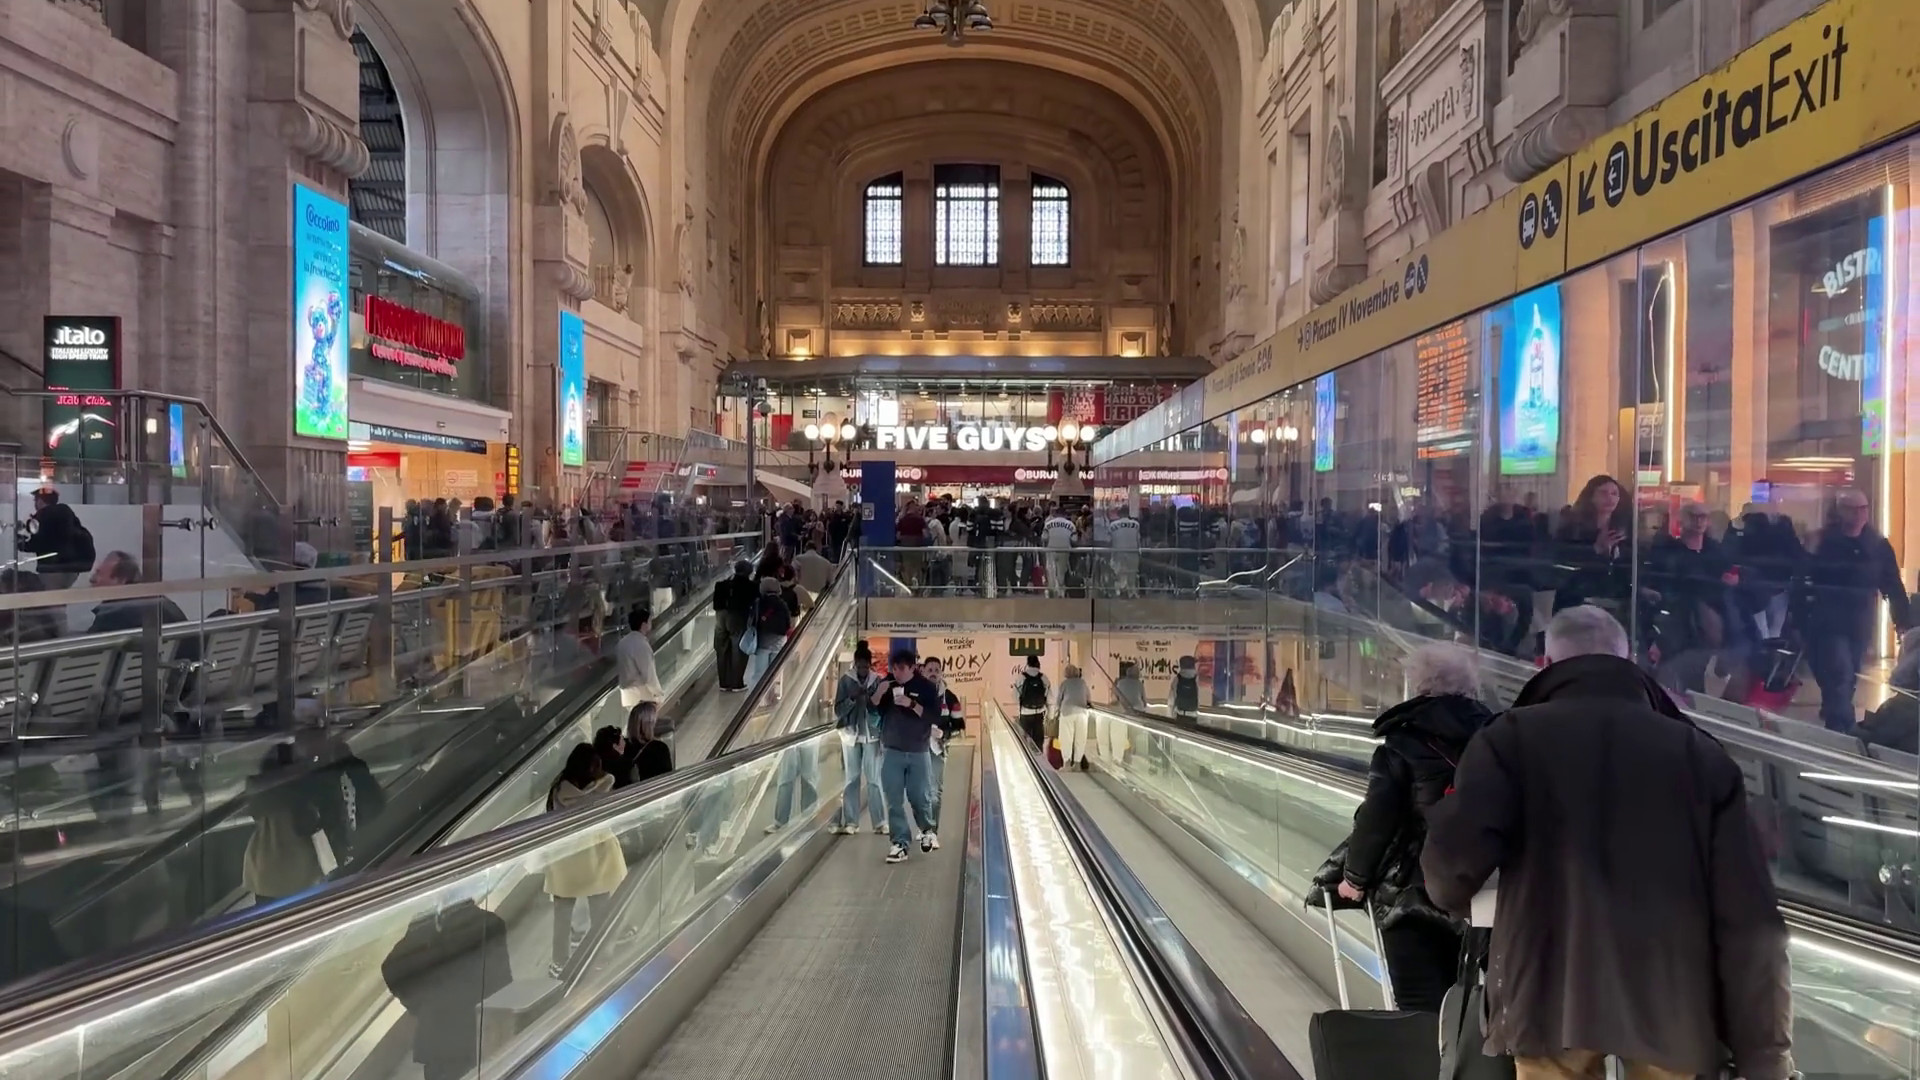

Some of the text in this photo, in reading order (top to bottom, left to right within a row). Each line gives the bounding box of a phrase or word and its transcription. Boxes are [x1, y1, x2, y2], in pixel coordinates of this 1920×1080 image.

[1632, 25, 1848, 196] Uscita Exit
[1312, 280, 1399, 344] Piazza IV Novembre
[877, 426, 1049, 450] FIVE GUYS
[895, 483, 911, 492] AR
[929, 622, 955, 630] smoking
[942, 652, 991, 674] MOKY
